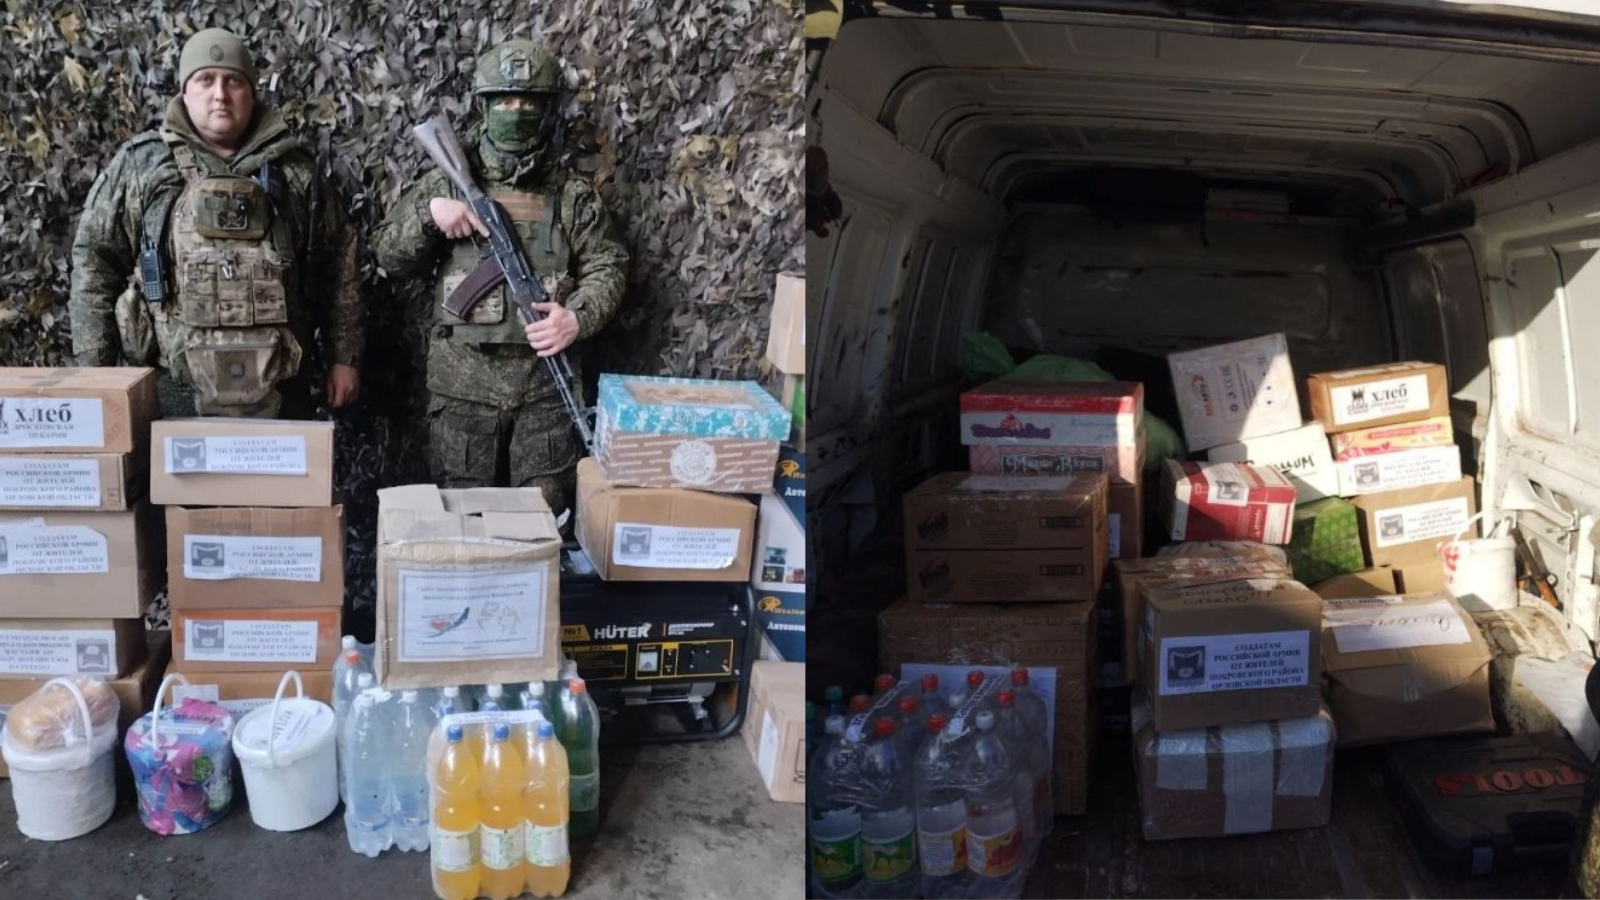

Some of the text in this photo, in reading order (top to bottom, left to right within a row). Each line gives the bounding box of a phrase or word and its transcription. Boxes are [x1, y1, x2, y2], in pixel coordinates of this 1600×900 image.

[15, 403, 72, 423] хлеб
[594, 624, 649, 640] HÜTER
[1235, 641, 1281, 651] СОЛДАТАМ
[1213, 649, 1301, 662] РОССИЙСКОЙ АРМИИ
[1231, 659, 1285, 670] ОТ ЖИТЕЛЕЙ
[1209, 667, 1305, 681] ПОКРОВСКОГО РАЙОНА
[1211, 676, 1302, 690] ОРЛОВСКОЙ ОБЛАСТИ
[1434, 764, 1585, 796] TOOLS
